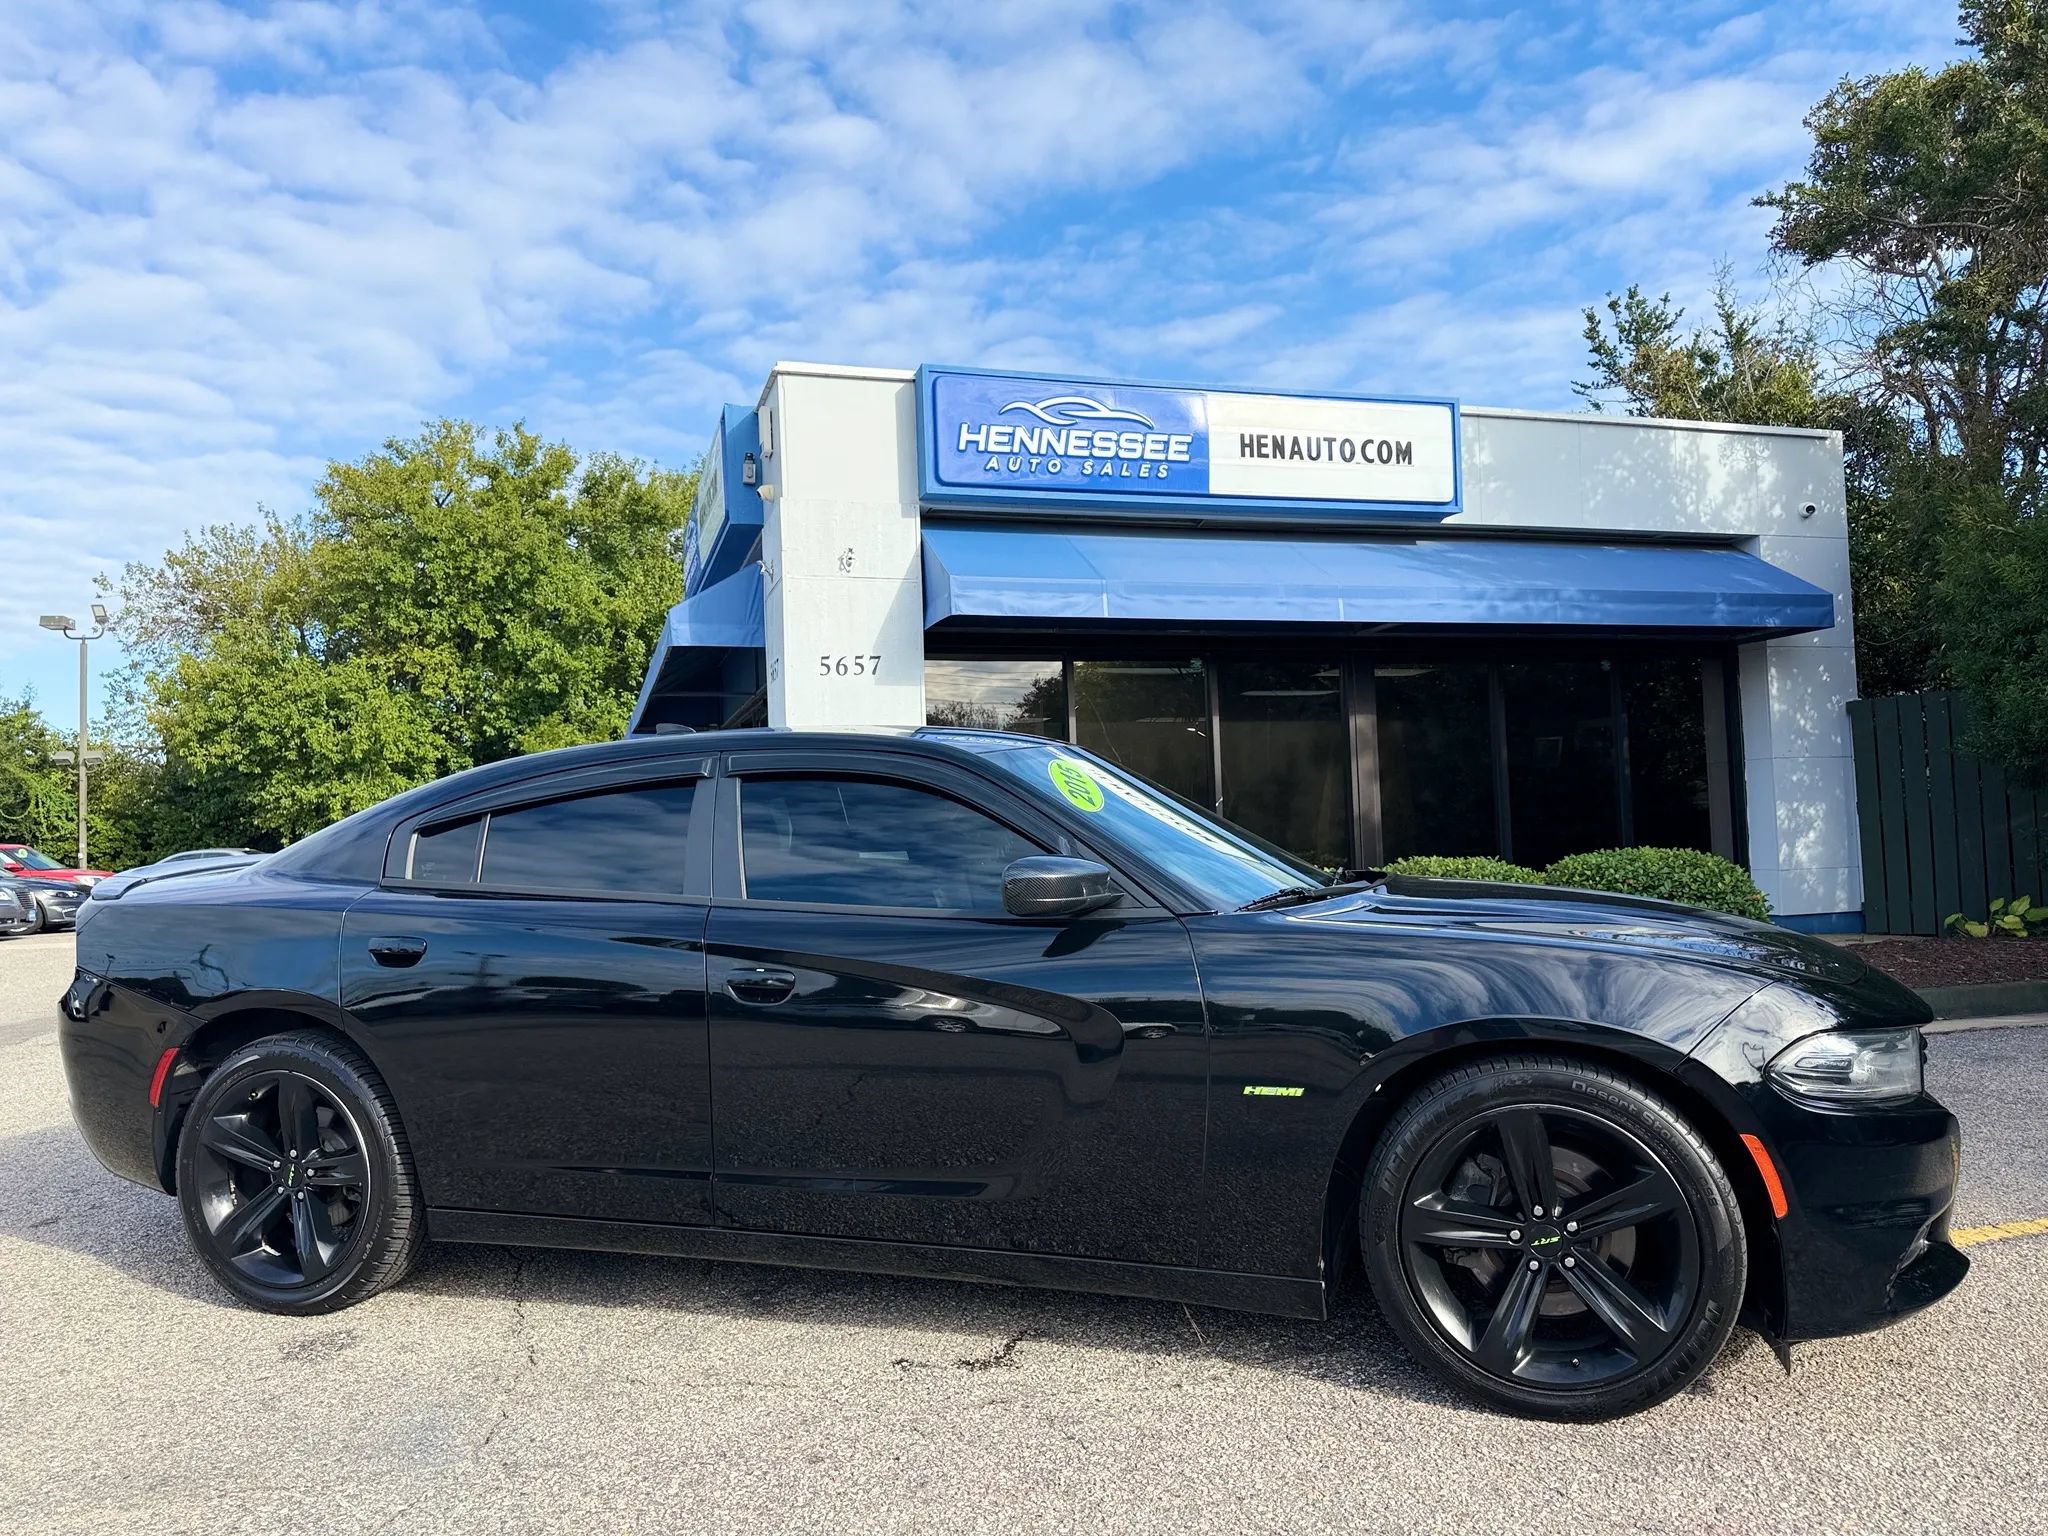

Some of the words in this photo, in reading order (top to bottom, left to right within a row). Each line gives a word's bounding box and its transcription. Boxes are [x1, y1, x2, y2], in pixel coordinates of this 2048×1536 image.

[958, 422, 1194, 462] HENNESSEE
[984, 455, 1061, 474] AUTO
[1081, 459, 1169, 479] SALES
[819, 654, 882, 676] 5657
[1056, 762, 1097, 808] 2015
[1243, 1085, 1305, 1097] HEMI
[1530, 1235, 1561, 1247] SRT
